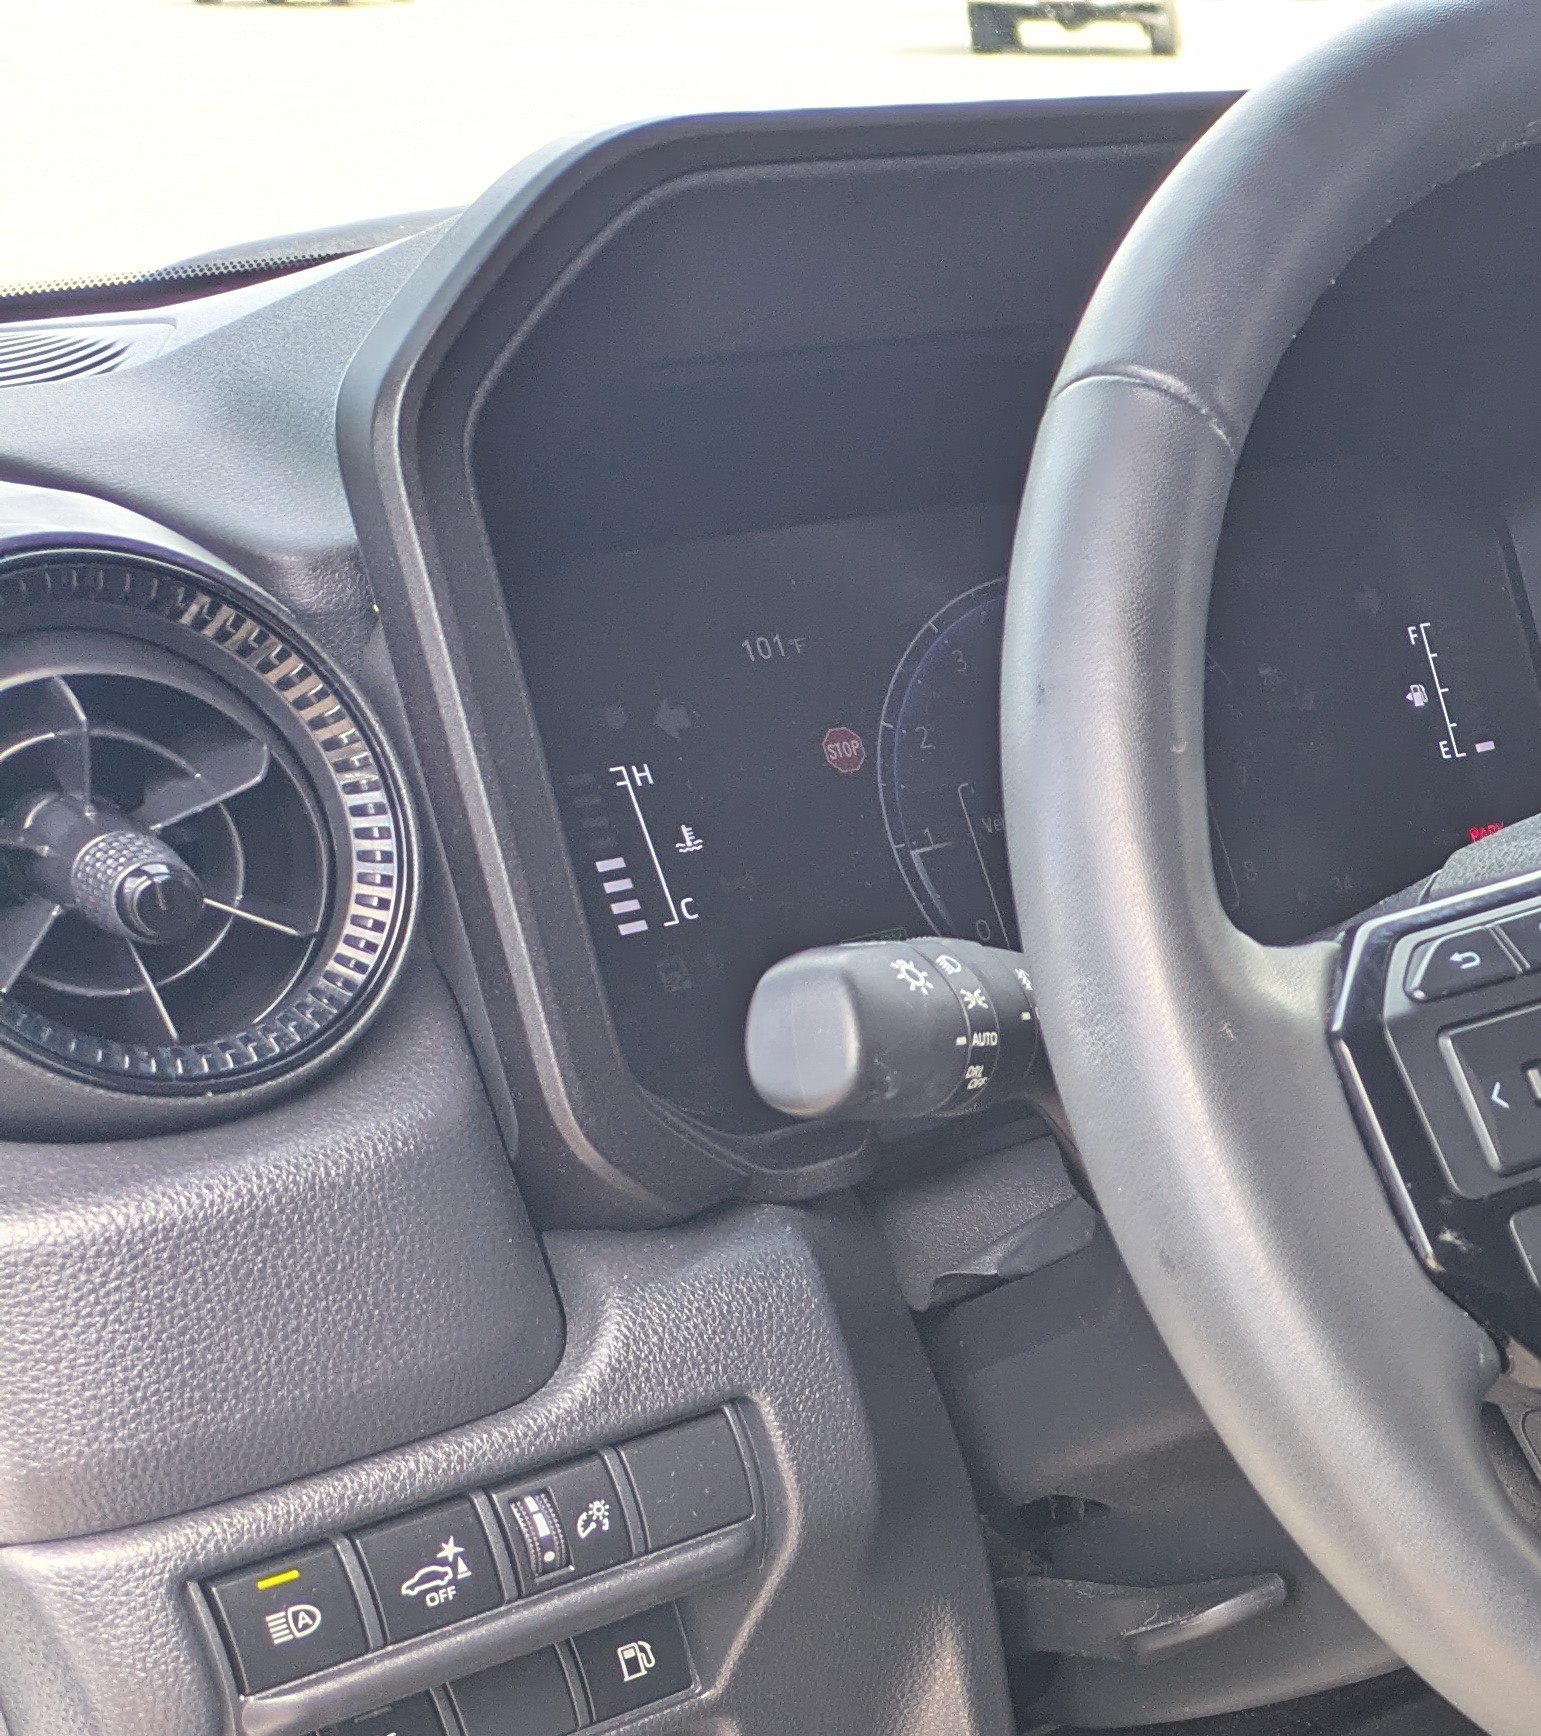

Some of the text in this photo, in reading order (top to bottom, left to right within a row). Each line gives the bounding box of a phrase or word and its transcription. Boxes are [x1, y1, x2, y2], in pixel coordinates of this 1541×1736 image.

[1407, 624, 1419, 646] F
[826, 738, 862, 762] STOP
[1439, 739, 1452, 760] E
[632, 764, 655, 787] H
[680, 897, 699, 920] C
[972, 1031, 998, 1047] AUTO
[425, 1585, 458, 1608] OFF
